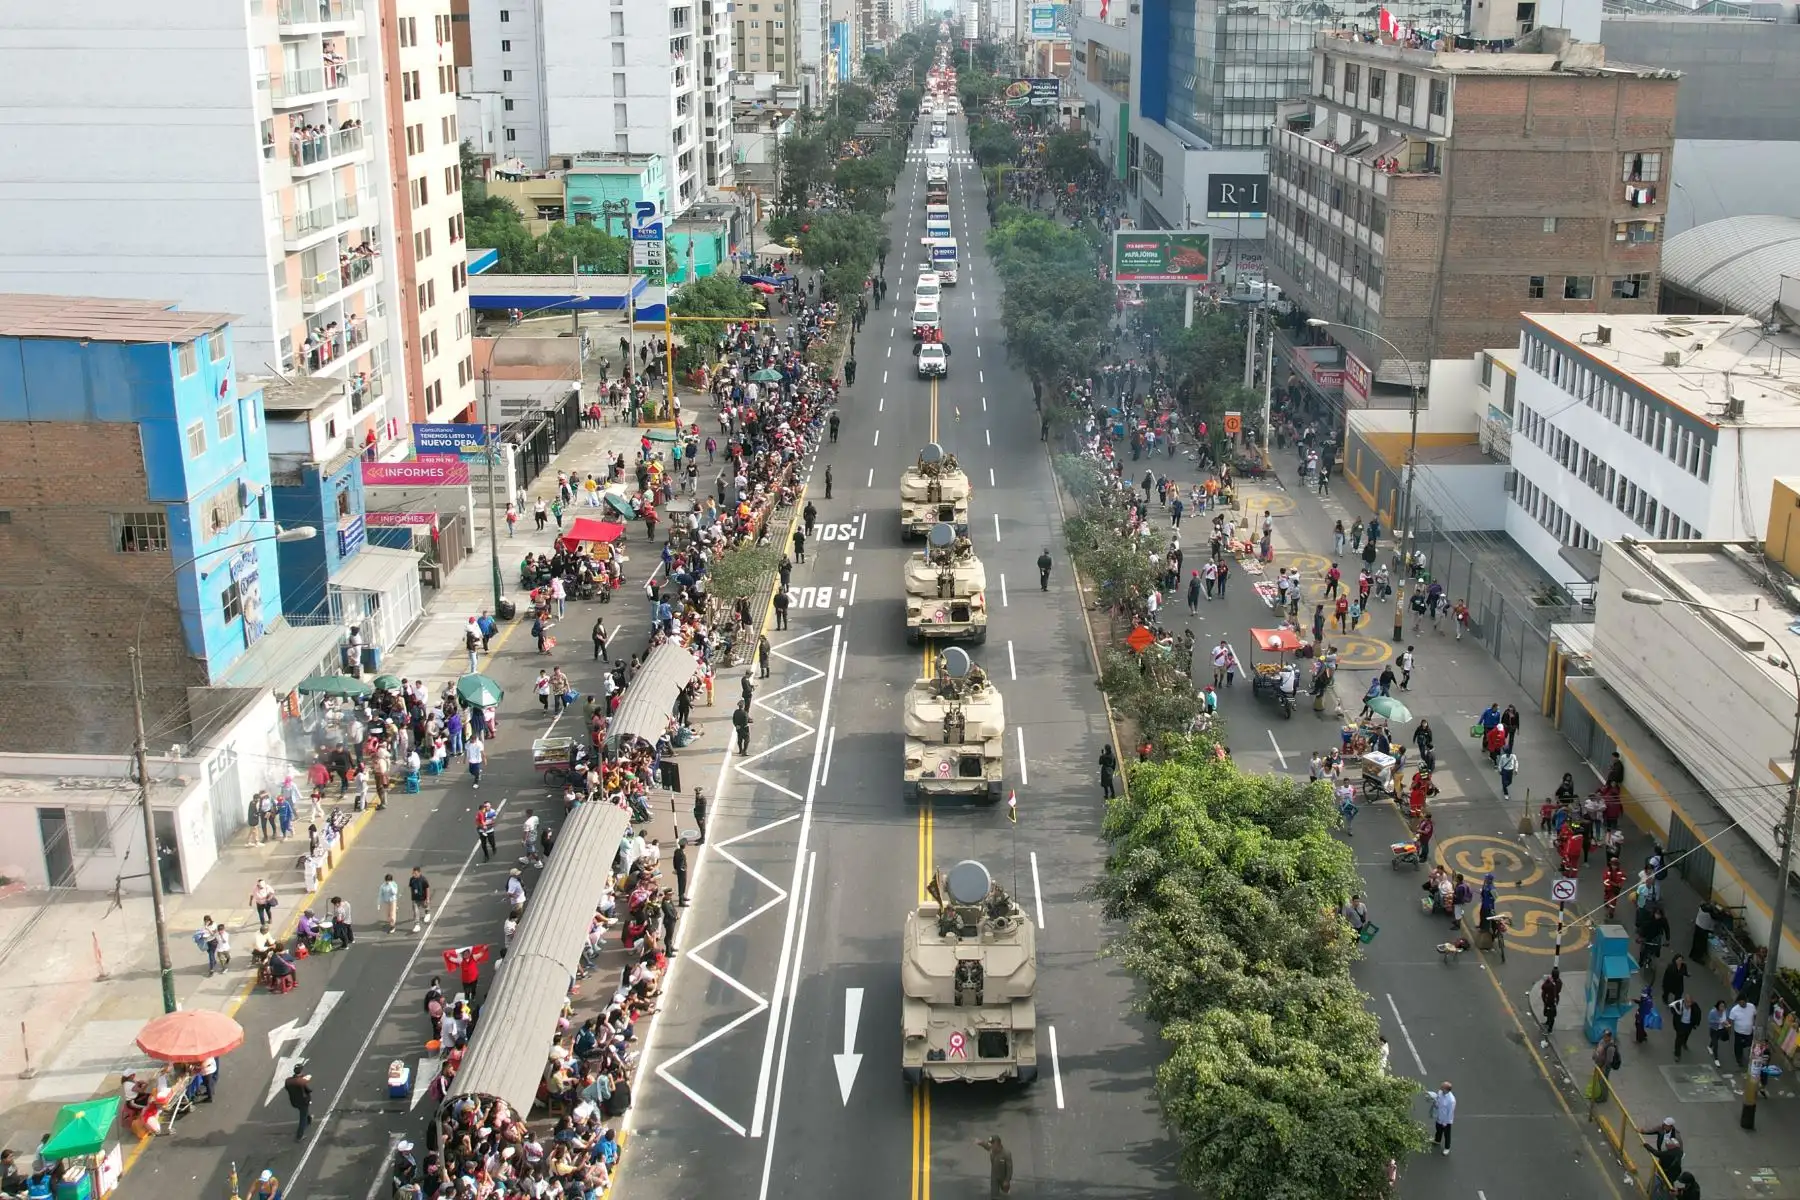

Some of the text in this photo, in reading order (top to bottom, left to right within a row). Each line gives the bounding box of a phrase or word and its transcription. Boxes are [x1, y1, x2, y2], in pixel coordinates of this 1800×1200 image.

[1241, 253, 1262, 262] Paga
[421, 439, 478, 447] NUEVO DEPA
[385, 468, 444, 477] INFORMES
[380, 515, 425, 523] INFORMES
[797, 523, 852, 541] SOL
[784, 587, 833, 608] BUS
